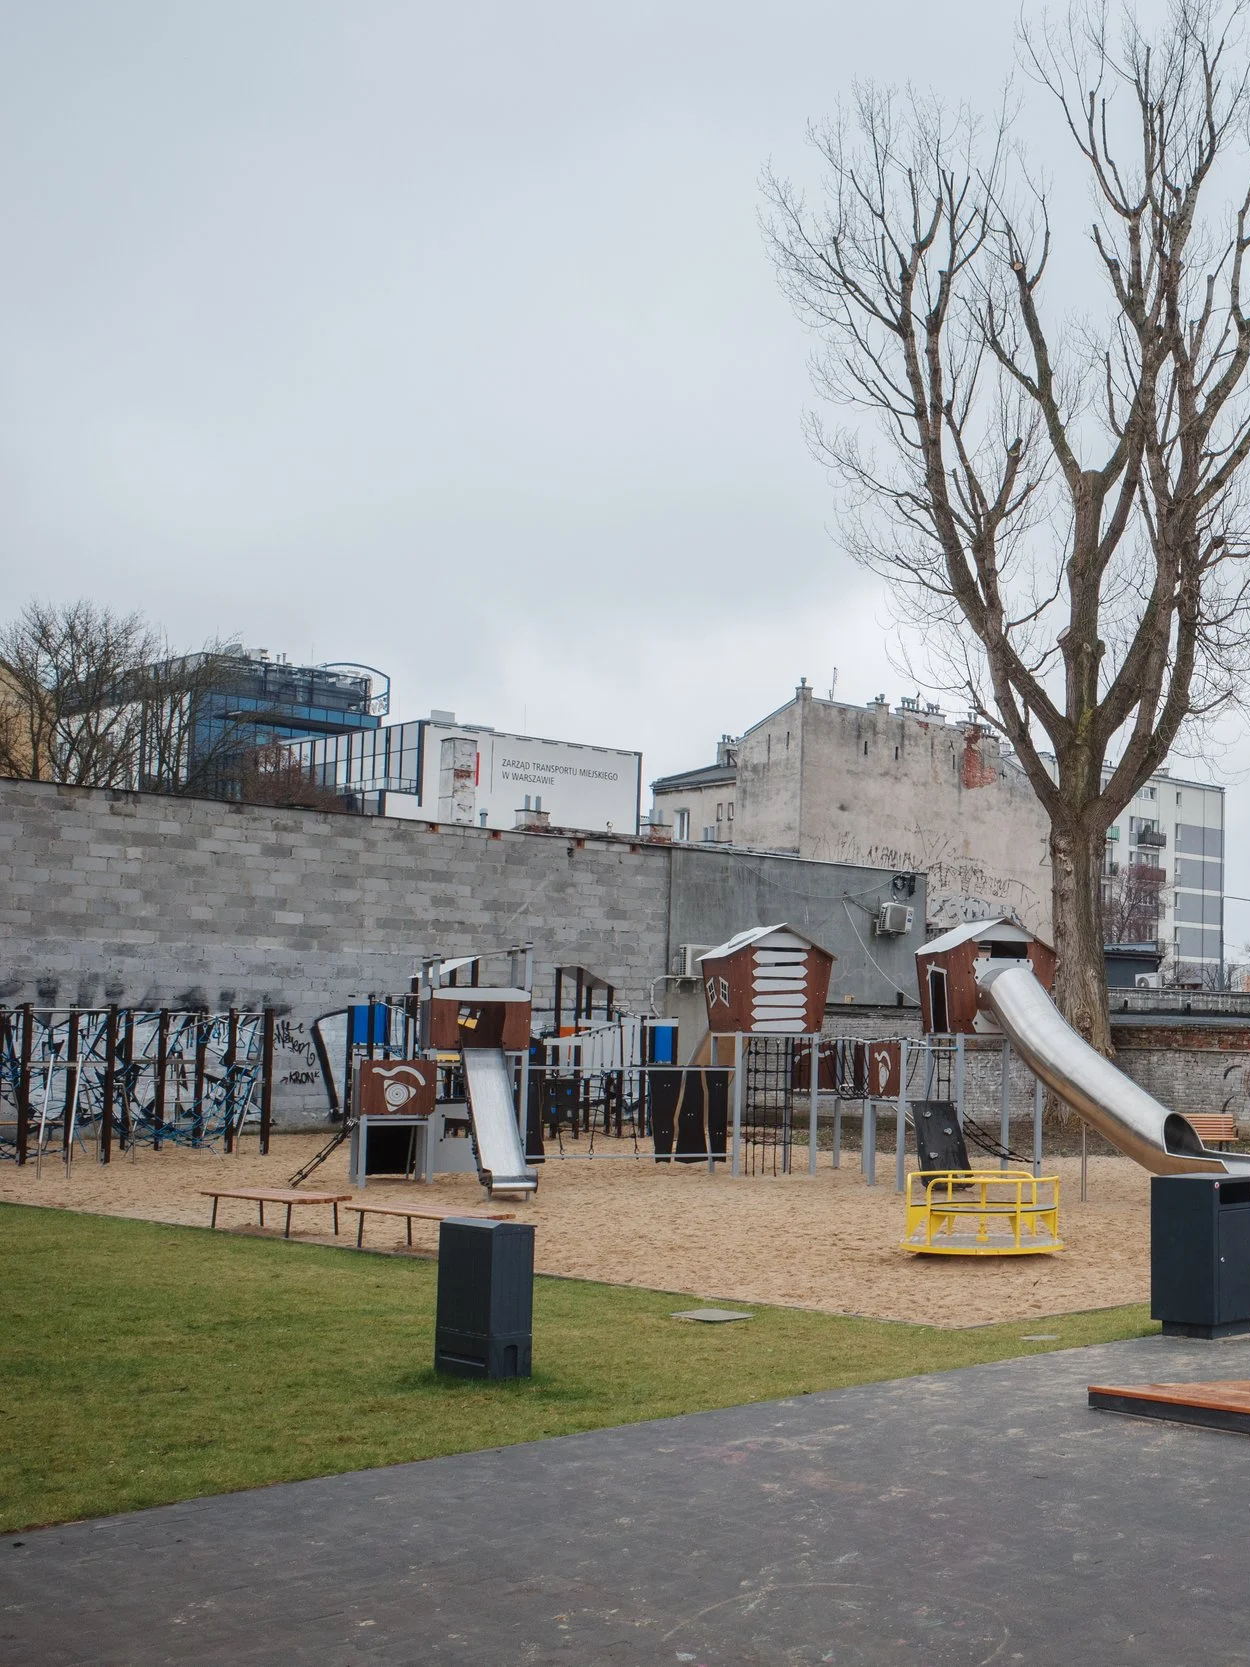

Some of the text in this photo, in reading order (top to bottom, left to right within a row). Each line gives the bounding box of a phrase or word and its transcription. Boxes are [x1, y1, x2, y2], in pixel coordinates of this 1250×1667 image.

[502, 759, 618, 781] ZARZĄD TRANSPORTU MIEJSKIEGO
[502, 771, 554, 784] W WARSZAWIE
